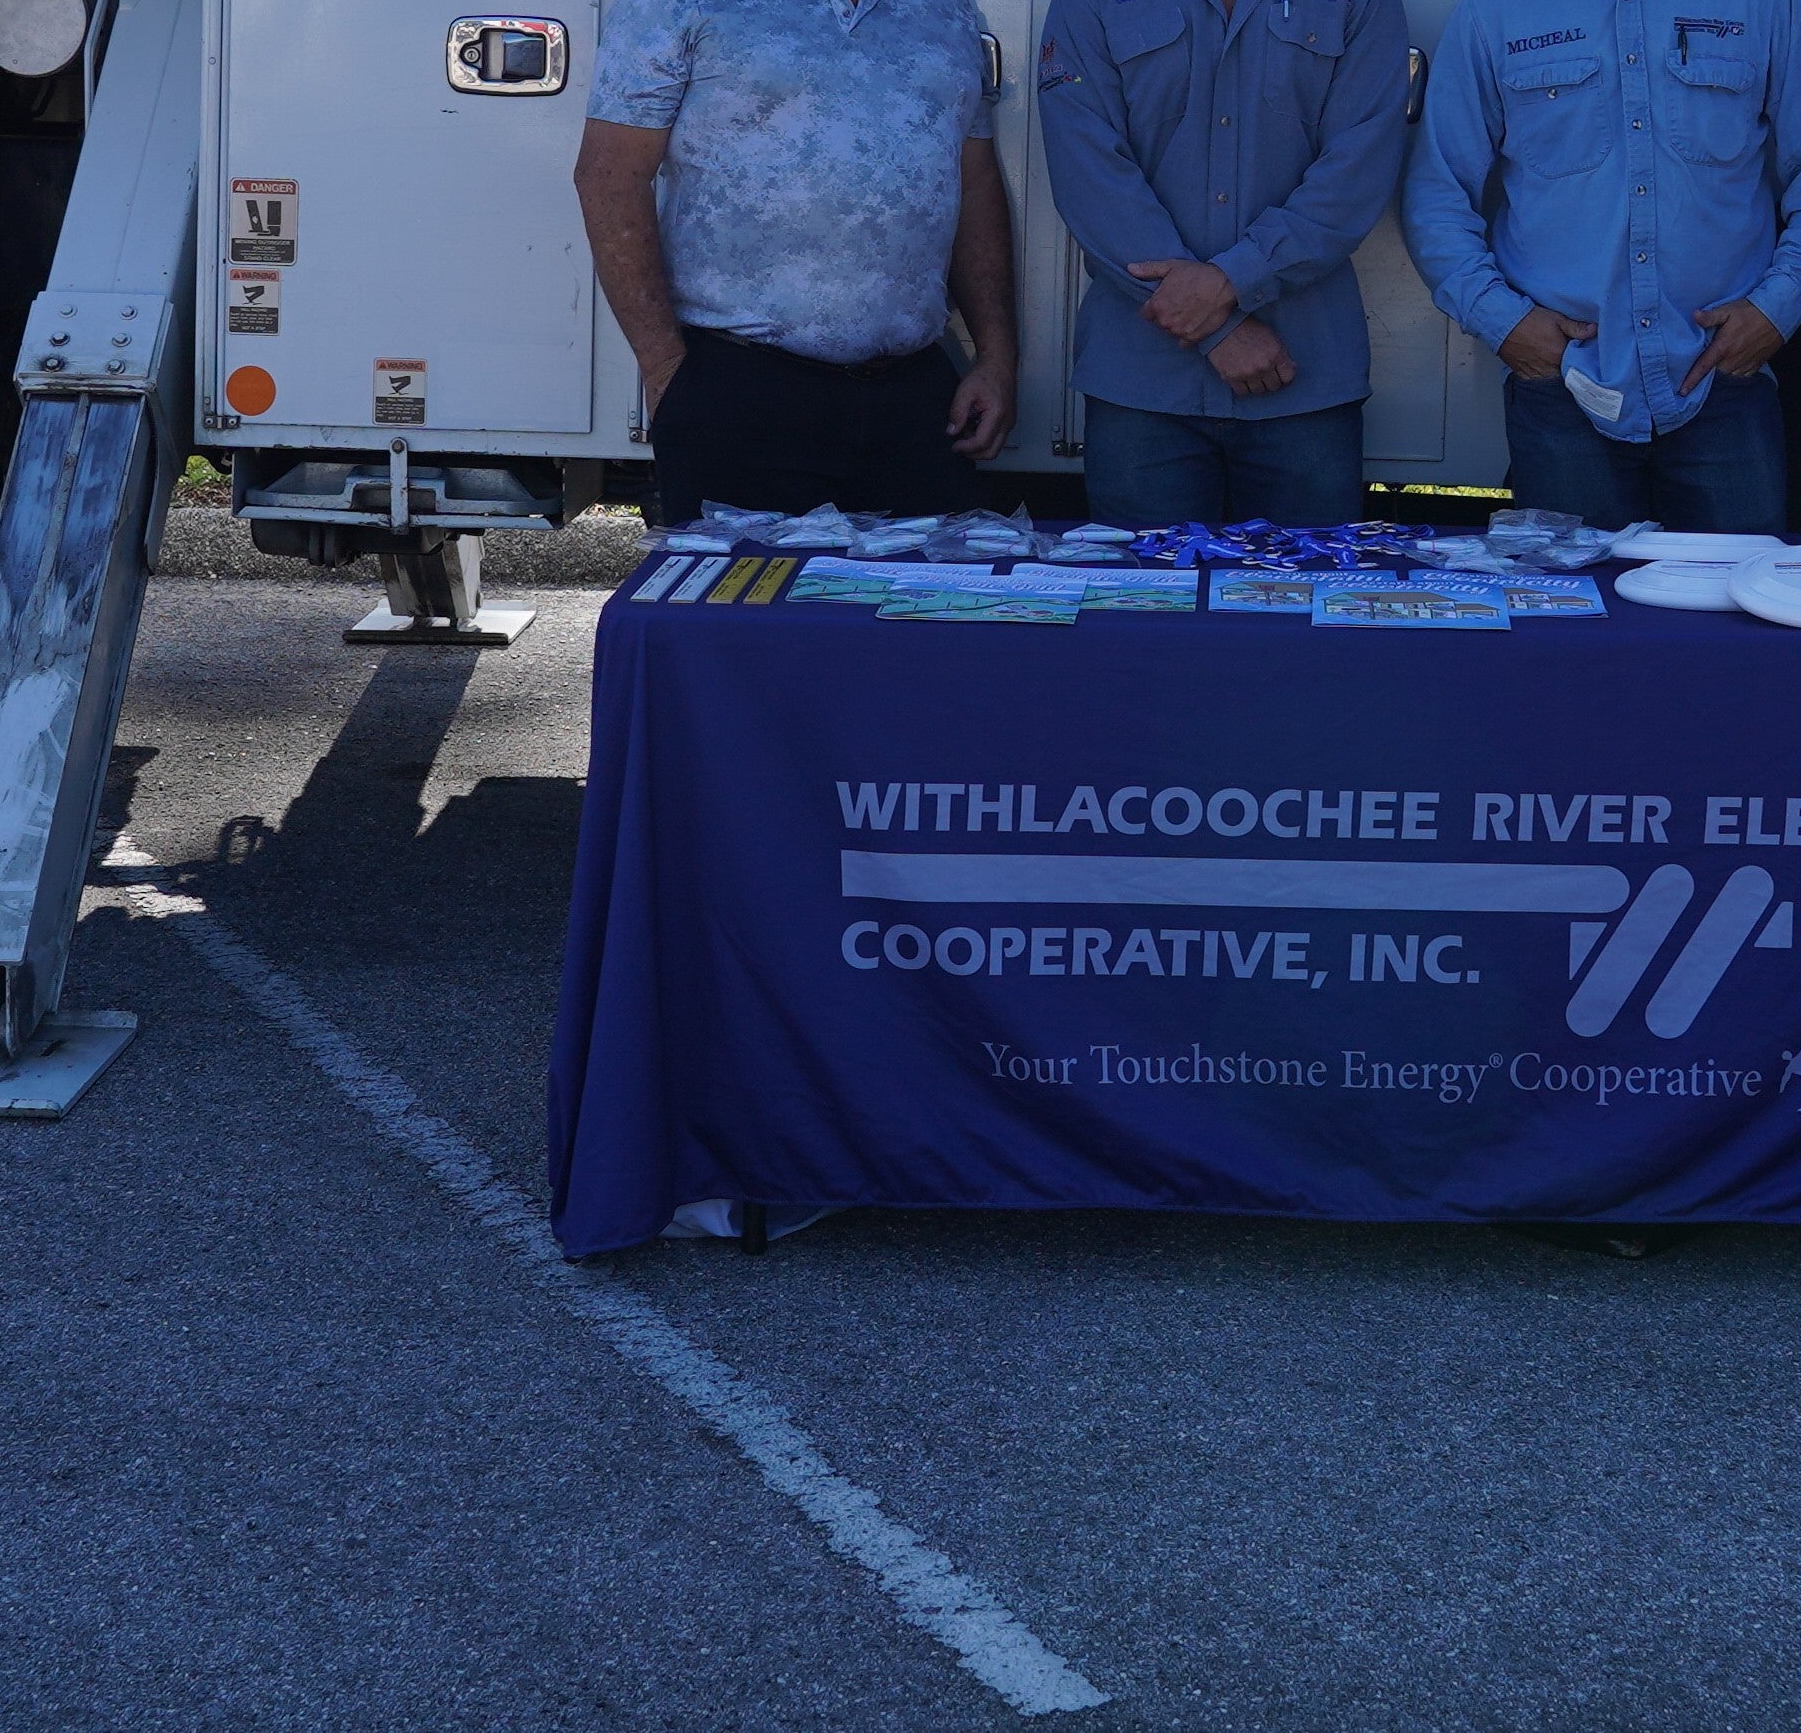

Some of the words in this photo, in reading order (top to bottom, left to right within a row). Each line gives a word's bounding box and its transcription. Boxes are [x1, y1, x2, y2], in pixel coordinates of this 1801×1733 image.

[1506, 27, 1586, 55] MICHEAL
[251, 183, 294, 193] DANGER
[241, 271, 277, 280] WARNING
[836, 781, 1440, 840] WITHLACOOCHEE
[1472, 792, 1672, 844] RIVER
[841, 920, 1329, 989] COOPERATIVE,
[1349, 933, 1480, 984] INC.
[981, 1042, 1078, 1085] Your
[1089, 1042, 1327, 1088] Touchstone
[1509, 1051, 1763, 1105] Cooperative
